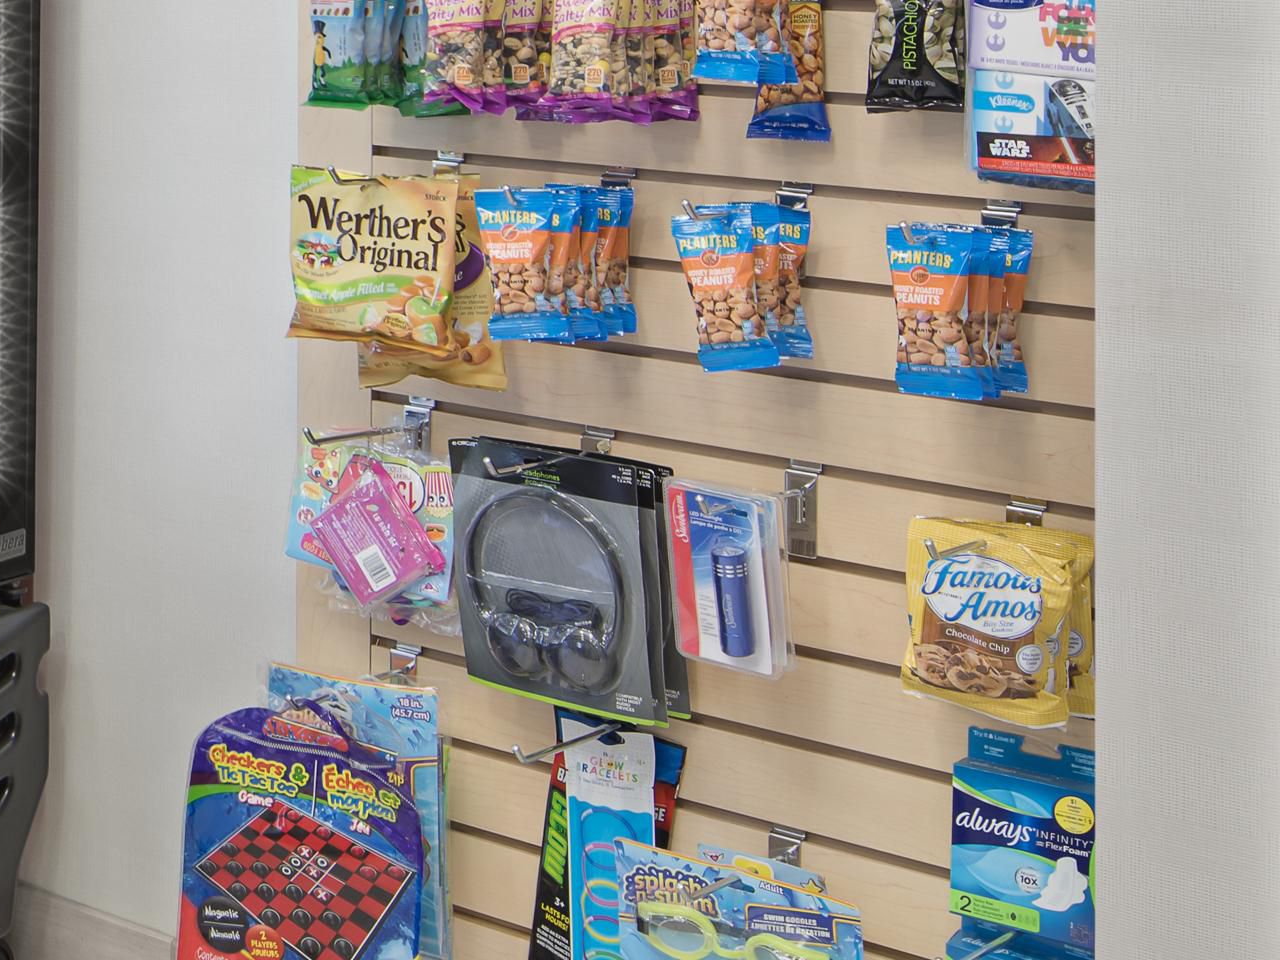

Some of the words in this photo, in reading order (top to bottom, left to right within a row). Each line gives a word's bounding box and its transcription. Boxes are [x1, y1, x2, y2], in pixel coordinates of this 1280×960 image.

[458, 4, 482, 17] Mix
[988, 139, 1027, 149] STAR
[989, 146, 1030, 158] WARS
[298, 193, 447, 243] Werther's
[337, 230, 439, 274] Original
[921, 557, 1042, 595] Famous
[944, 591, 1041, 622] Amos
[945, 628, 988, 649] Chocolate
[989, 643, 1010, 655] Chip
[398, 698, 409, 708] 18
[391, 708, 410, 719] (45.7
[412, 710, 430, 721] cm)
[209, 744, 286, 777] Checkers
[238, 791, 274, 808] Game
[327, 791, 397, 822] morpion
[956, 807, 1032, 847] always
[1036, 830, 1089, 849] INFINITY
[1045, 841, 1089, 858] FlexFoam
[759, 881, 784, 895] Adult
[1020, 875, 1038, 886] 10X
